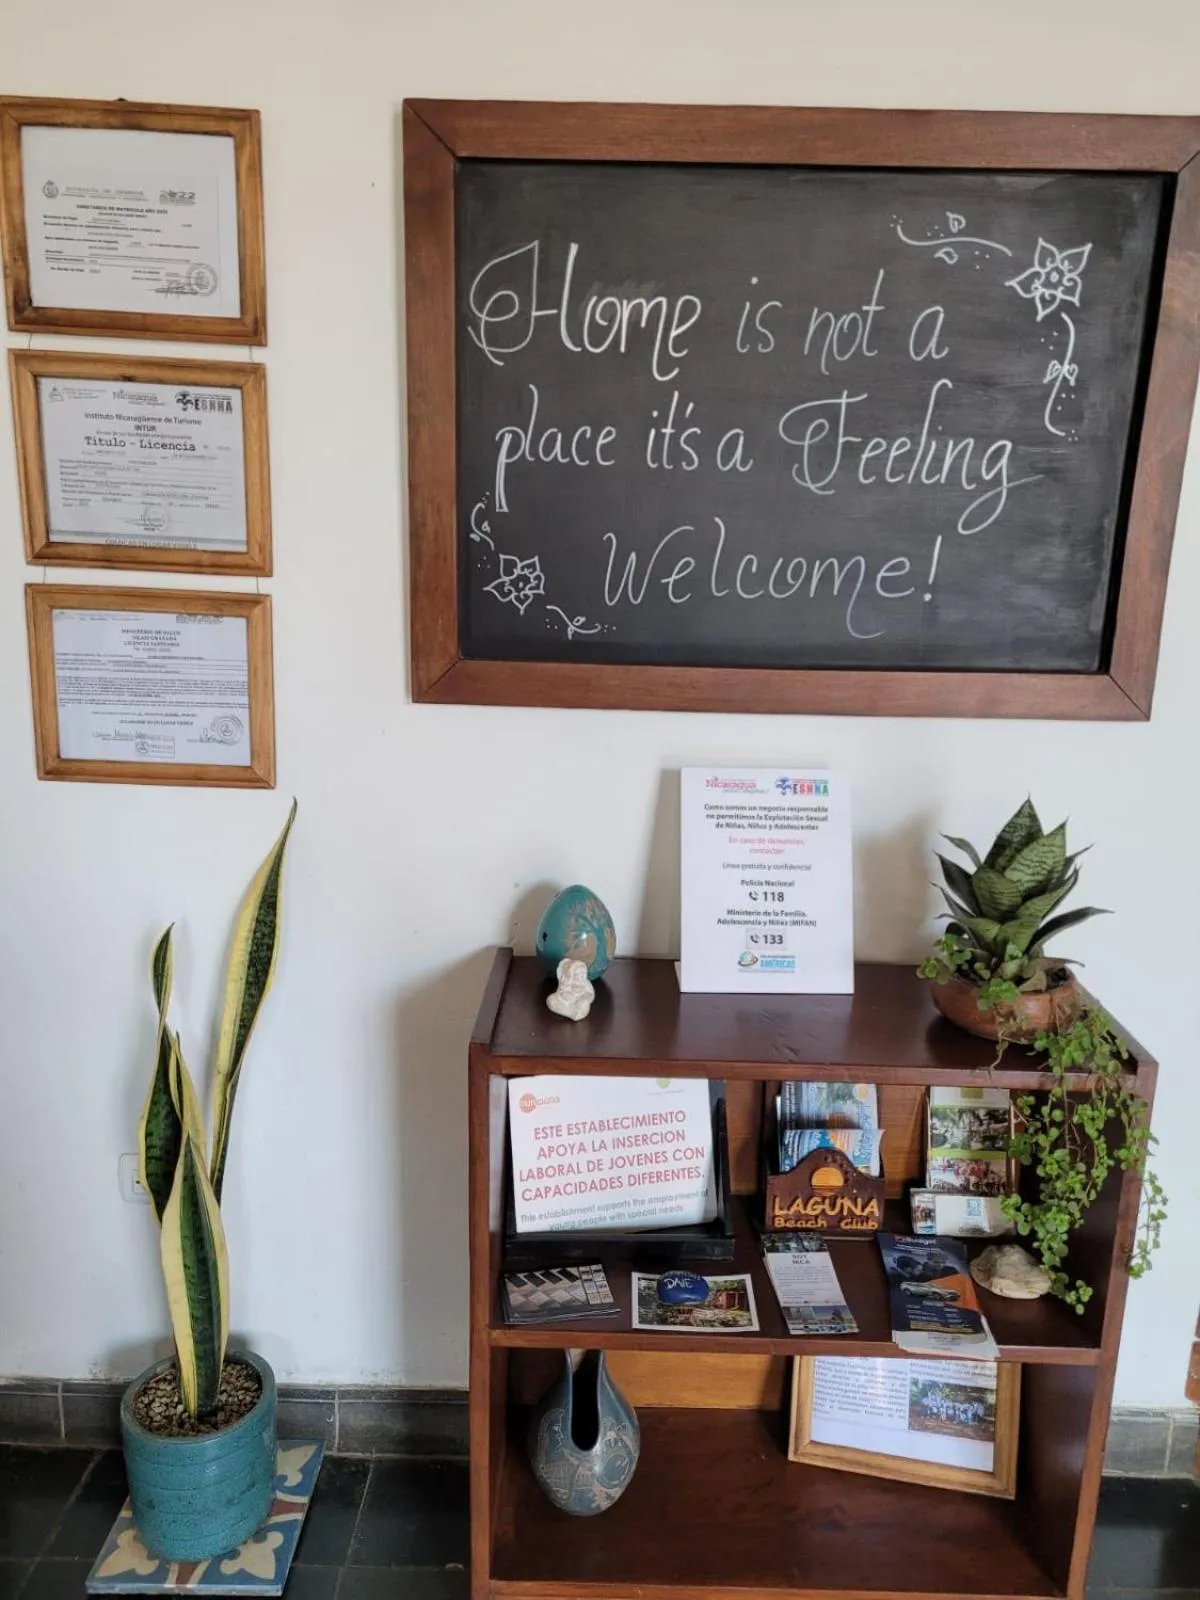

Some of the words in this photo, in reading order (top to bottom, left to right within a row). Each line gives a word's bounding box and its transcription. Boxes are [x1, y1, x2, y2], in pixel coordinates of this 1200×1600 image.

[468, 240, 701, 381] Home
[735, 275, 783, 356] is
[803, 268, 885, 375] not
[908, 303, 949, 361] a
[84, 412, 114, 420] Instituto
[163, 416, 172, 424] de
[139, 439, 196, 452] Licencia
[494, 384, 616, 513] place
[645, 390, 702, 473] it's
[716, 427, 754, 473] a
[778, 379, 1045, 536] Feeling
[601, 517, 943, 640] Welcome!
[704, 803, 724, 811] Como
[726, 804, 747, 812] somos
[758, 804, 786, 814] negocio
[788, 805, 828, 814] responsable
[716, 812, 756, 822] permitimos
[774, 823, 818, 831] Adolescentes
[764, 880, 796, 888] Nacional
[762, 891, 785, 902] 118
[727, 909, 761, 917] Ministerio
[716, 918, 762, 926] Adolescencia
[762, 934, 784, 945] 133
[534, 1124, 563, 1141] ESTE
[566, 1110, 687, 1135] ESTABLECIMIENTO
[537, 1141, 588, 1160] APOYA
[591, 1137, 608, 1153] LA
[612, 1129, 686, 1150] INSERCION
[519, 1160, 583, 1182] LABORAL
[586, 1157, 604, 1173] DE
[608, 1150, 668, 1170] JOVENES
[672, 1146, 706, 1162] CON
[521, 1174, 624, 1202] CAPACIDADES
[627, 1166, 705, 1187] DIFERENTES.
[520, 1212, 536, 1224] This
[538, 1202, 596, 1220] establishment
[597, 1198, 632, 1213] supports
[632, 1196, 646, 1208] the
[774, 1196, 880, 1217] LAGUNA
[577, 1214, 608, 1228] people
[609, 1212, 626, 1222] with
[627, 1207, 658, 1222] special
[658, 1204, 684, 1215] needs
[774, 1216, 828, 1229] Beach
[840, 1217, 879, 1230] Club
